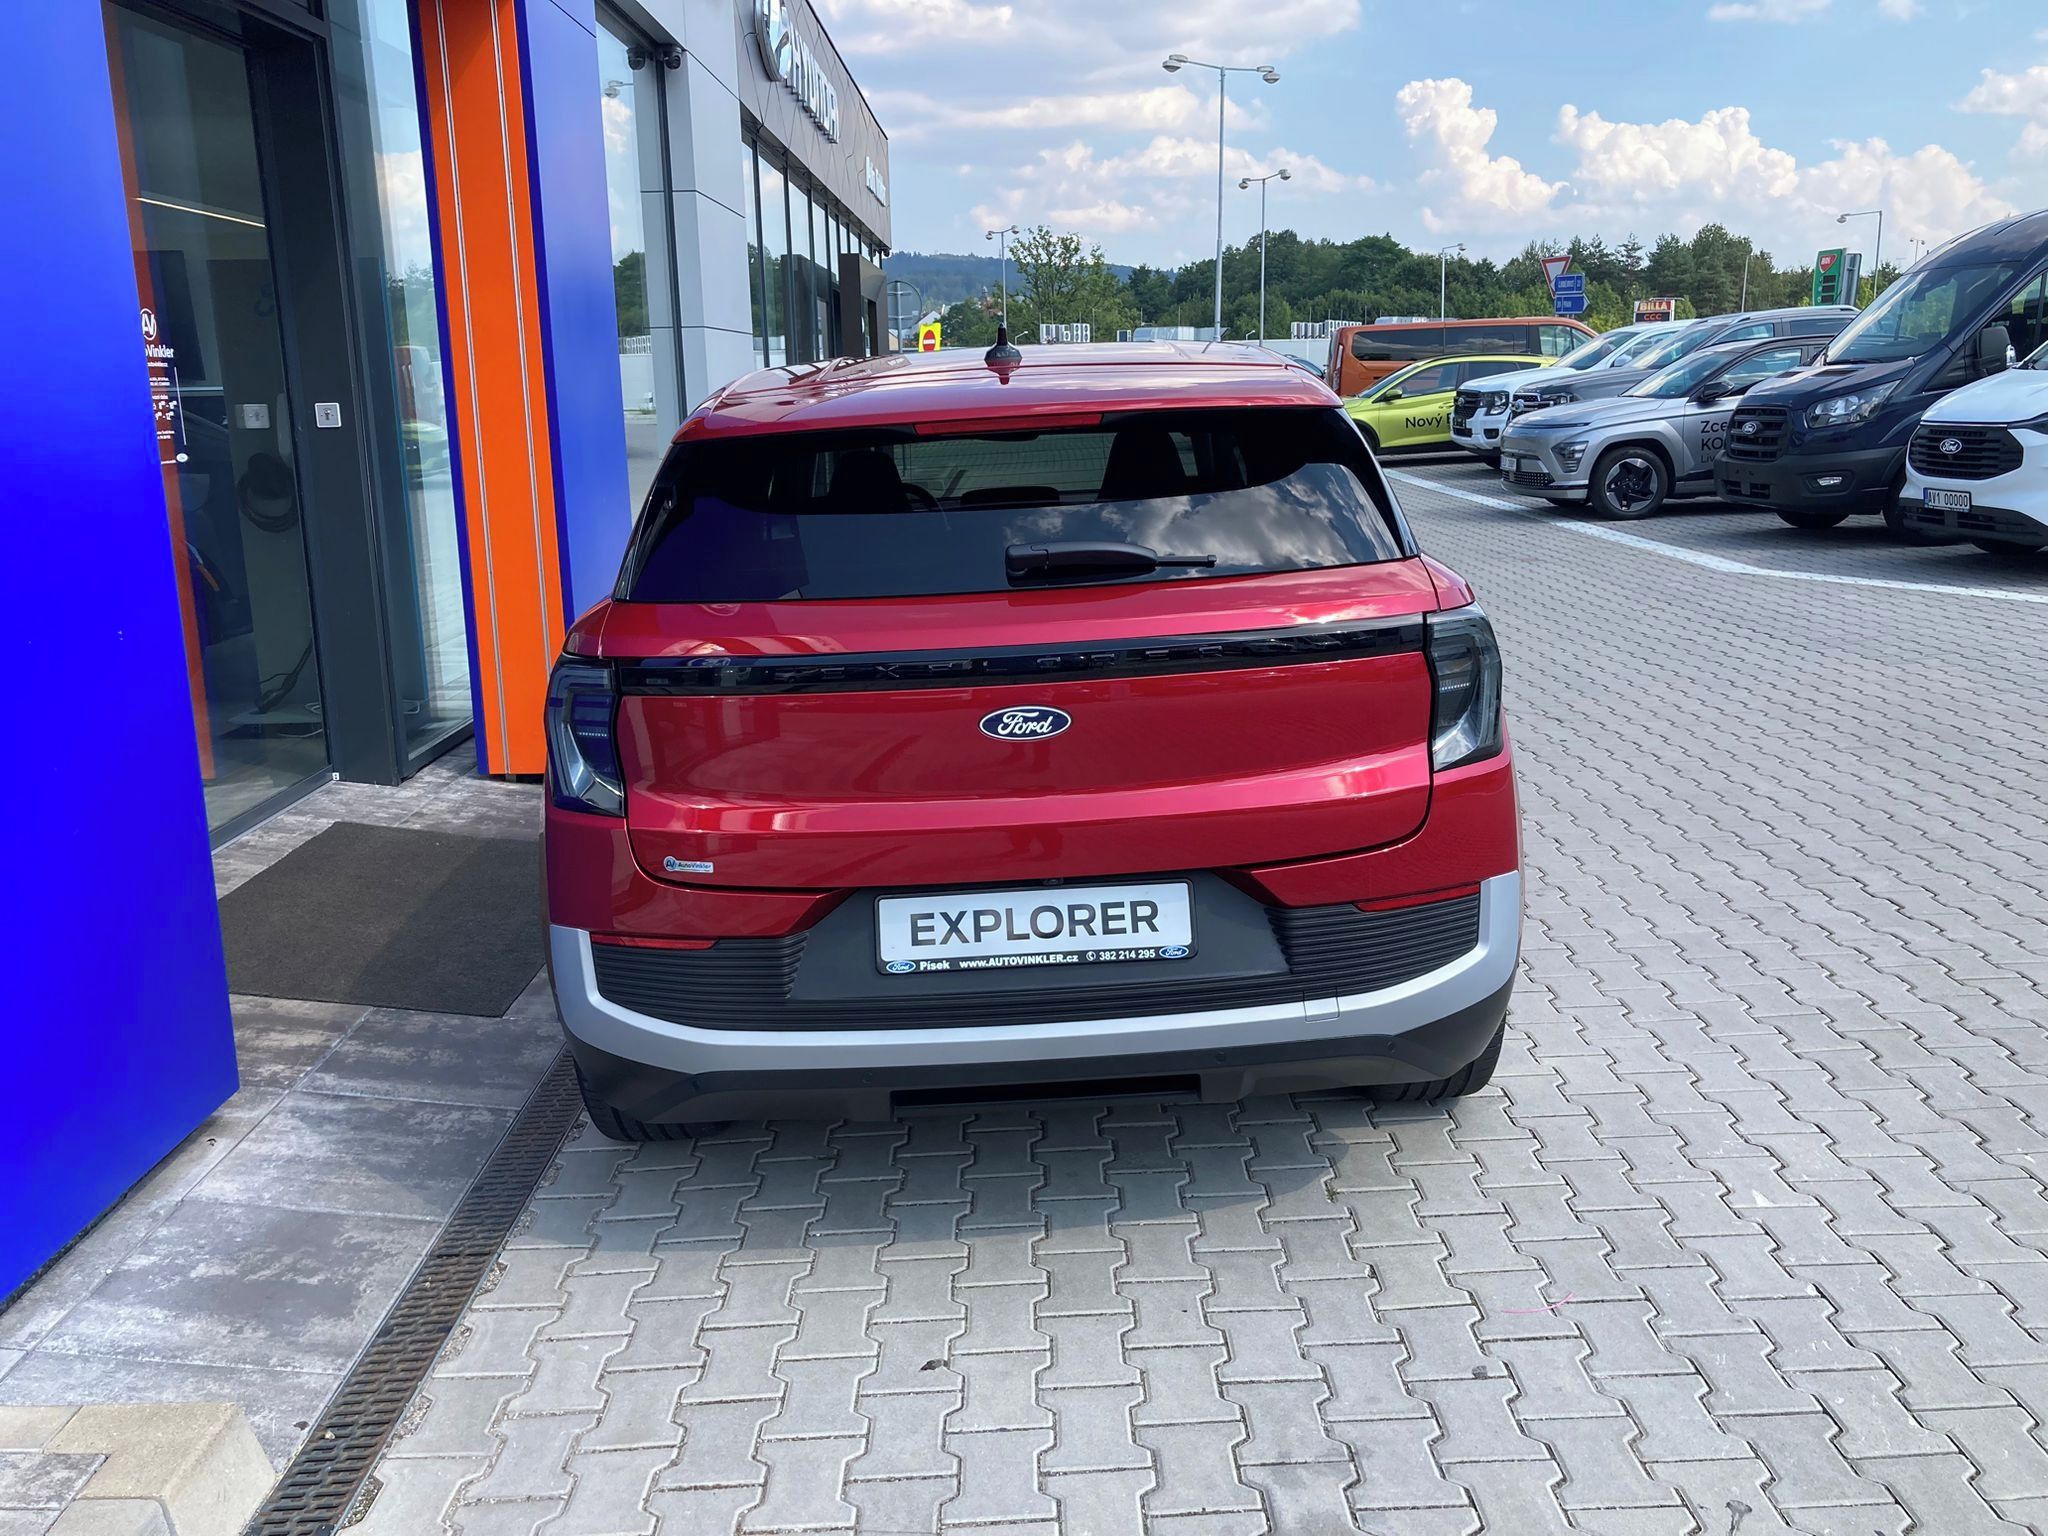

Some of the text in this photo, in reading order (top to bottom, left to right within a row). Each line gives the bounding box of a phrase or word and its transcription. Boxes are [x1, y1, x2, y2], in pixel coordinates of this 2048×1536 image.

[1639, 301, 1667, 311] BILLA
[1405, 413, 1443, 428] Nový
[1700, 420, 1728, 434] Zce
[1701, 437, 1726, 451] KO
[1701, 454, 1715, 464] Liv
[996, 710, 1054, 735] Ford
[910, 899, 1160, 947] EXPLORER
[919, 960, 951, 971] Písek
[959, 953, 1079, 969] www.AUTOVINKLER.cz
[1099, 951, 1117, 961] 382
[1118, 950, 1136, 960] 214
[1138, 949, 1156, 959] 295
